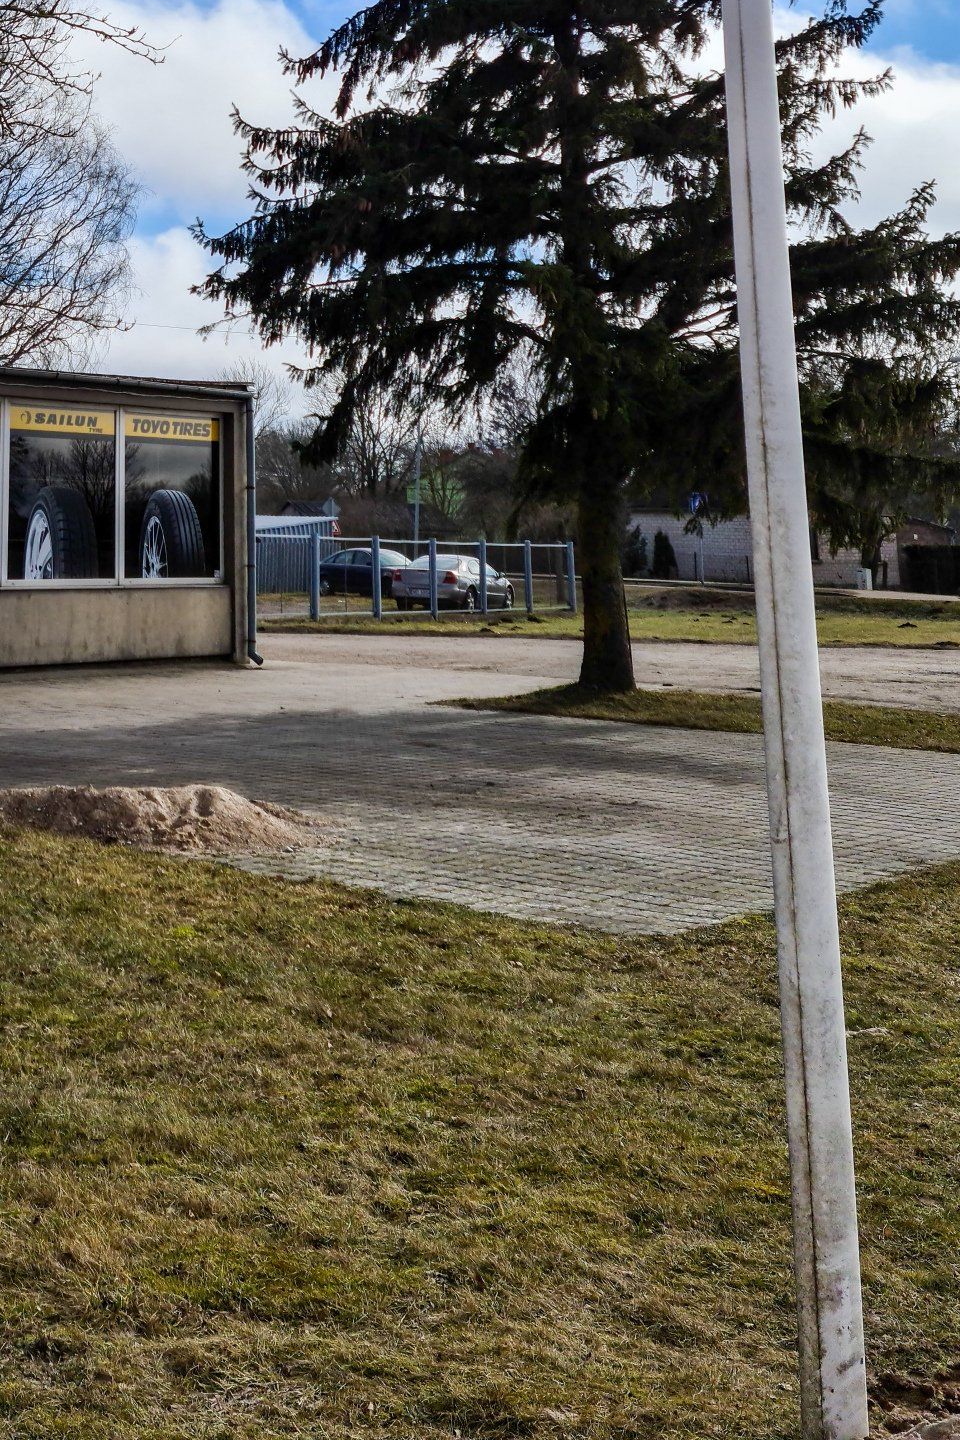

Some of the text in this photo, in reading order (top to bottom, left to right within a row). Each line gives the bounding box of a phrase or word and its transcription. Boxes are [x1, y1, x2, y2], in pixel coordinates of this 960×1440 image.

[34, 412, 98, 428] SAILUN
[132, 418, 211, 438] TOYO TIRES
